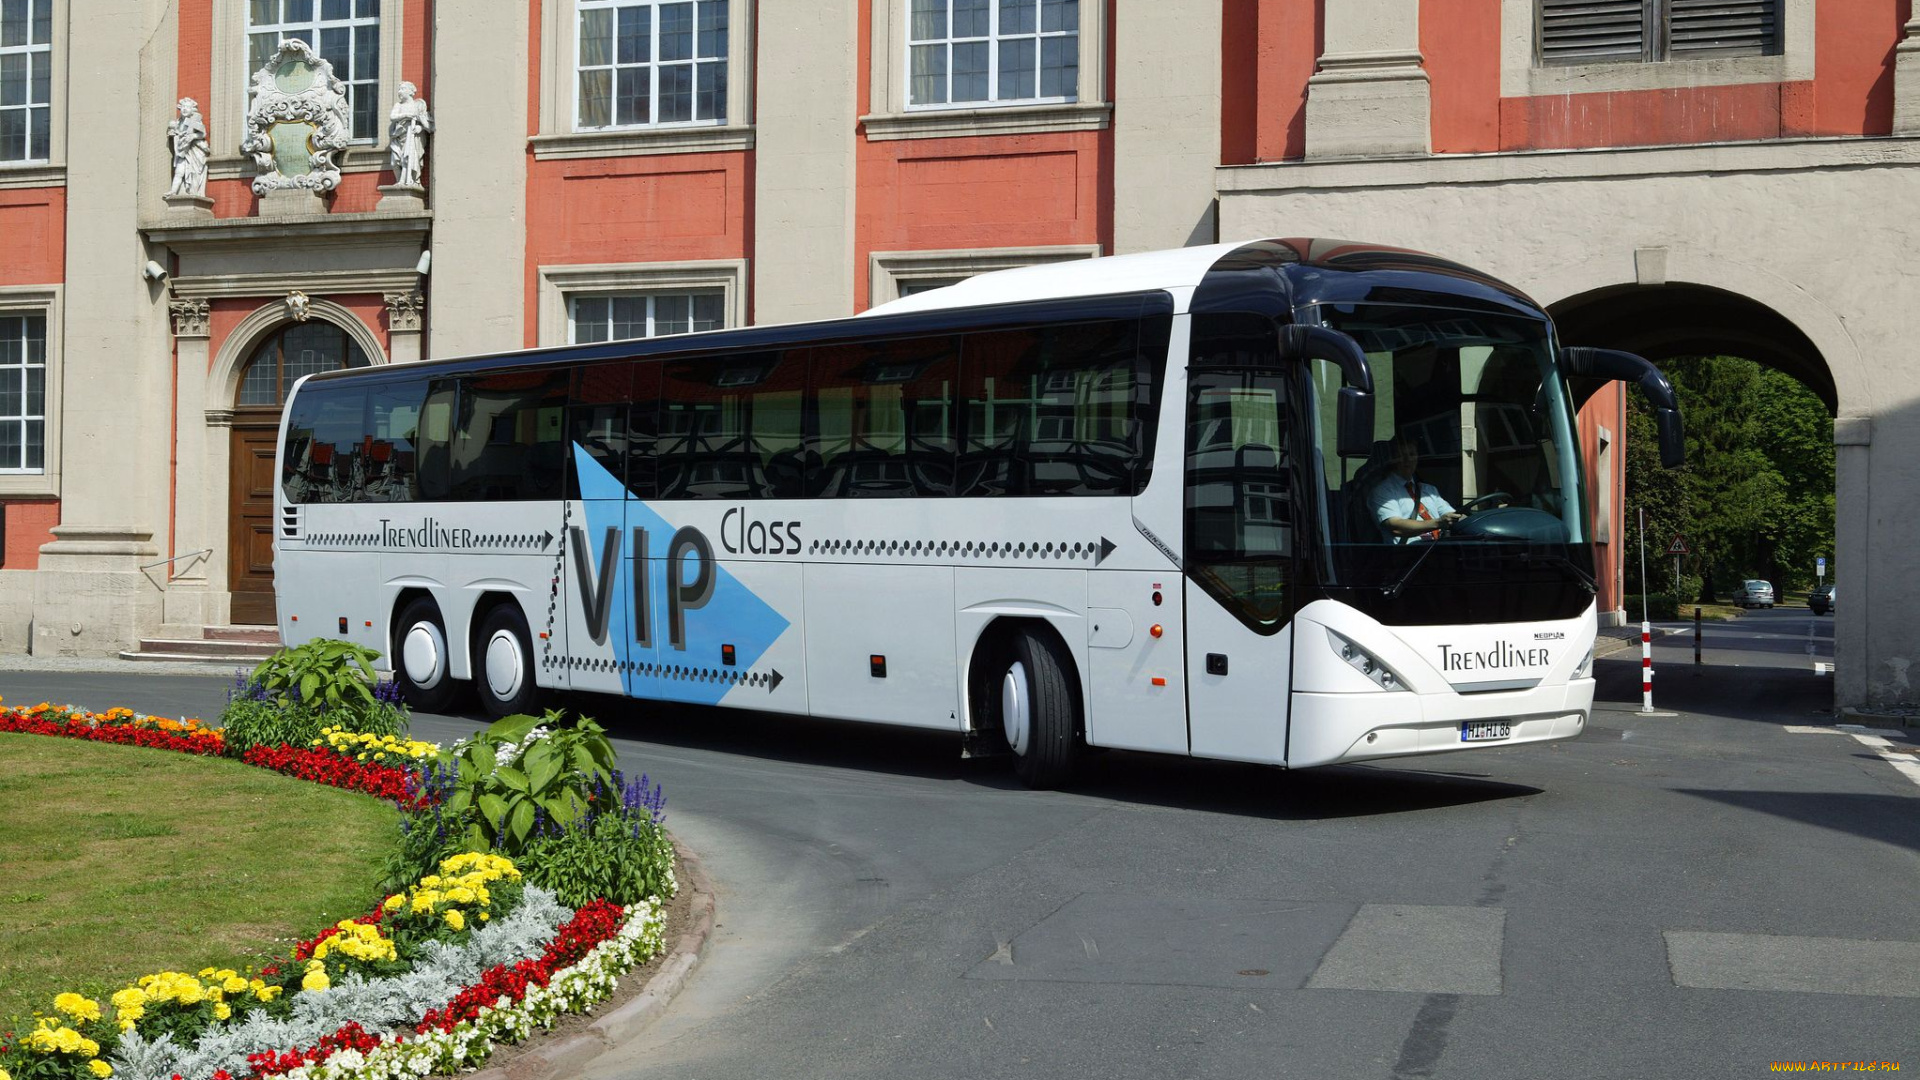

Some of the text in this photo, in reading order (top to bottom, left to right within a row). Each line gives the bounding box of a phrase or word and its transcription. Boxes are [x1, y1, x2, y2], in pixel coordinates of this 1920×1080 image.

[569, 506, 802, 652] VIP Class
[1533, 631, 1565, 640] NEOPLAN
[1500, 722, 1511, 737] 86
